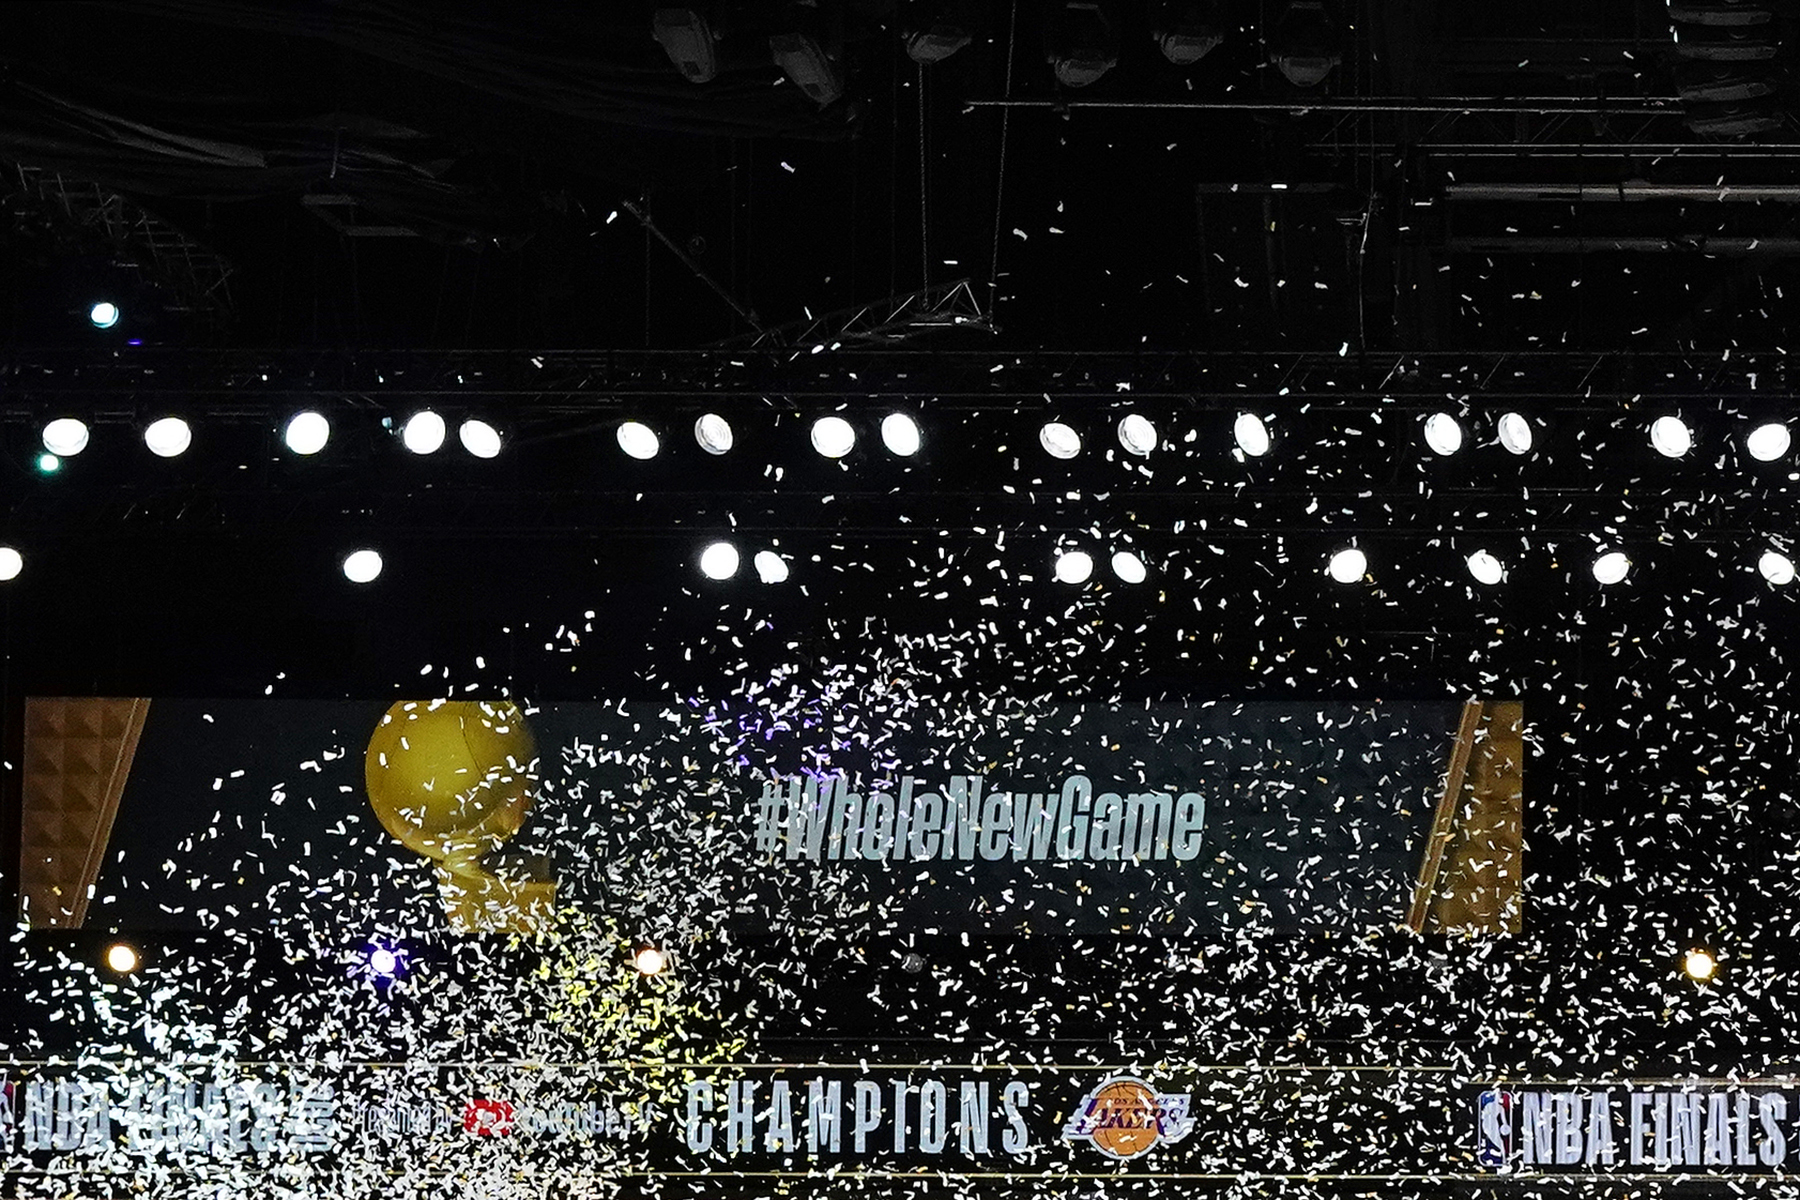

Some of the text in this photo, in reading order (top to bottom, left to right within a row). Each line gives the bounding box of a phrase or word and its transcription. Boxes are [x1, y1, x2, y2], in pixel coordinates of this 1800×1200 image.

[755, 774, 1206, 861] #WholeNewGame
[686, 1079, 1030, 1155] CHAMPIONS
[1522, 1091, 1614, 1166] NBA
[1630, 1091, 1788, 1166] FINALS
